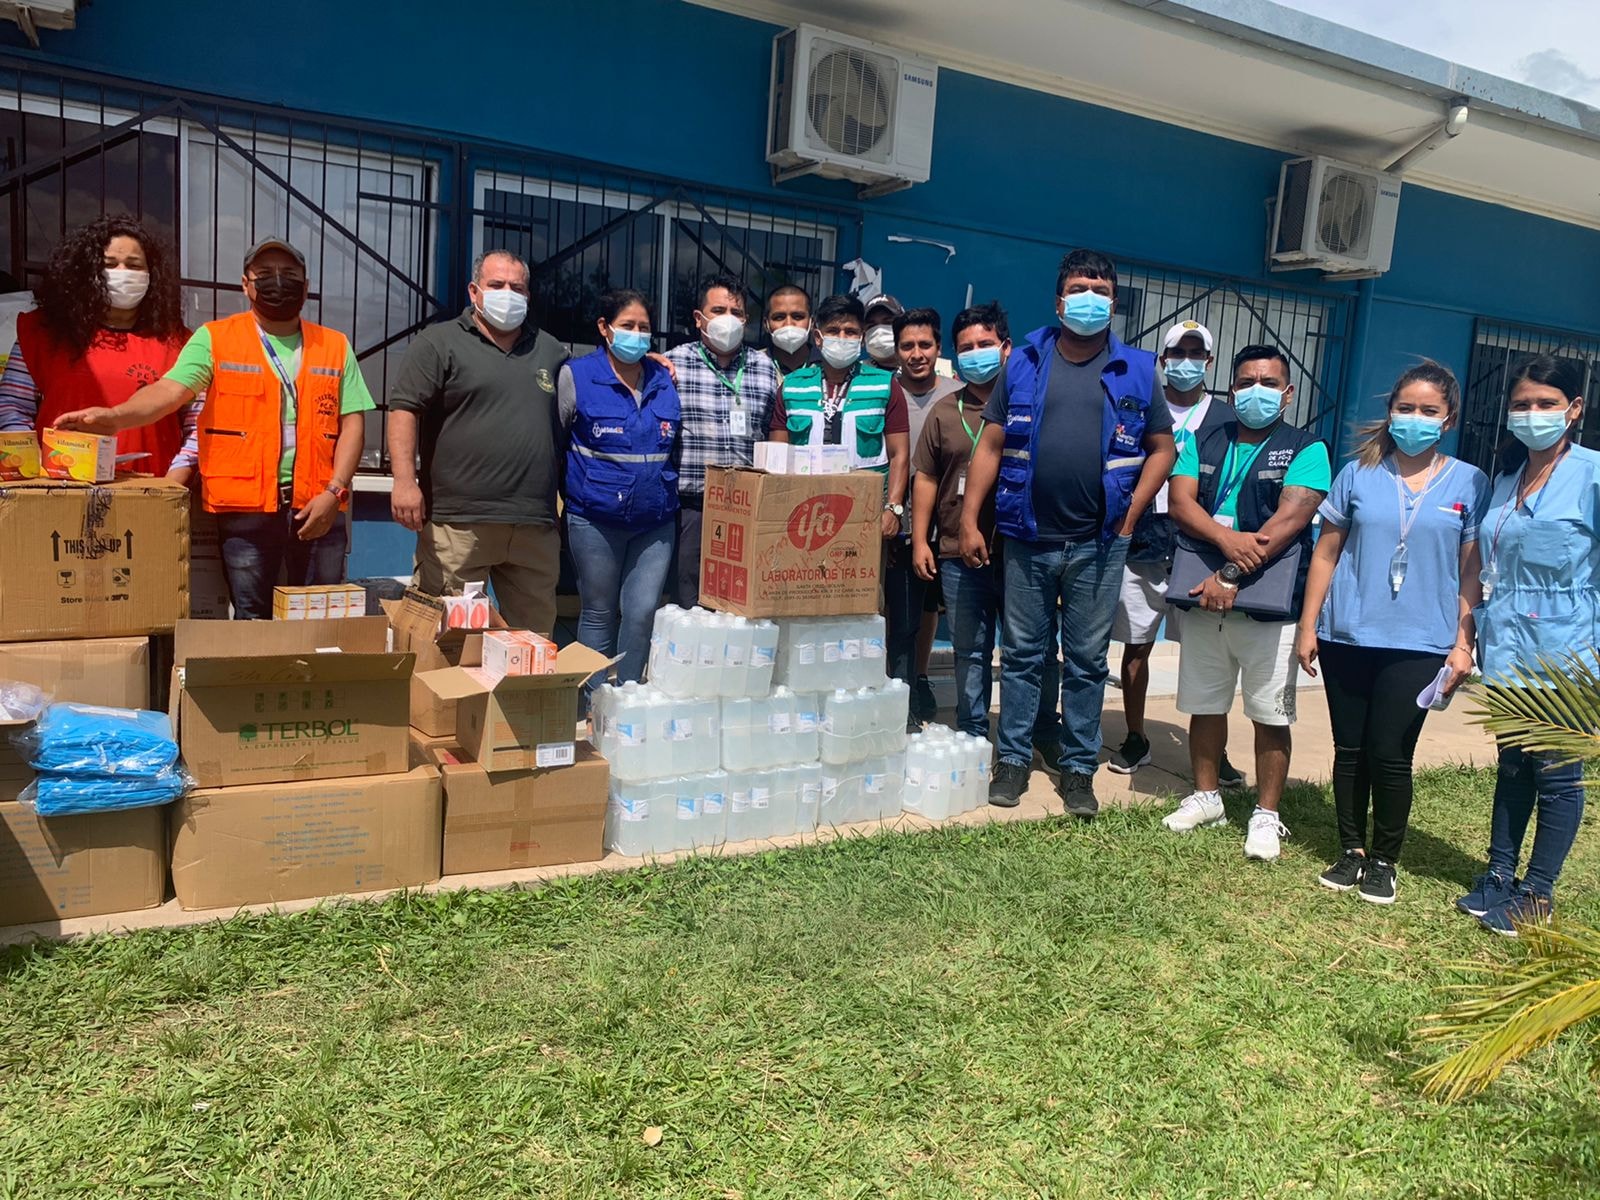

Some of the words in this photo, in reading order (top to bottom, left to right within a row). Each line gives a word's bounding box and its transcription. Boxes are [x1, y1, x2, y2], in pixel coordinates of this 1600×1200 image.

[903, 73, 934, 88] SAMSUNG
[1380, 189, 1399, 199] SAMSUNG
[708, 485, 752, 507] FRAGIL
[715, 525, 722, 540] 4
[63, 539, 85, 555] THIS
[845, 550, 858, 558] BPM
[761, 568, 838, 582] LABORATORIOS
[841, 567, 857, 580] IFA
[60, 596, 83, 604] Store
[262, 719, 359, 740] TERBOL
[254, 742, 297, 750] EMPRESA
